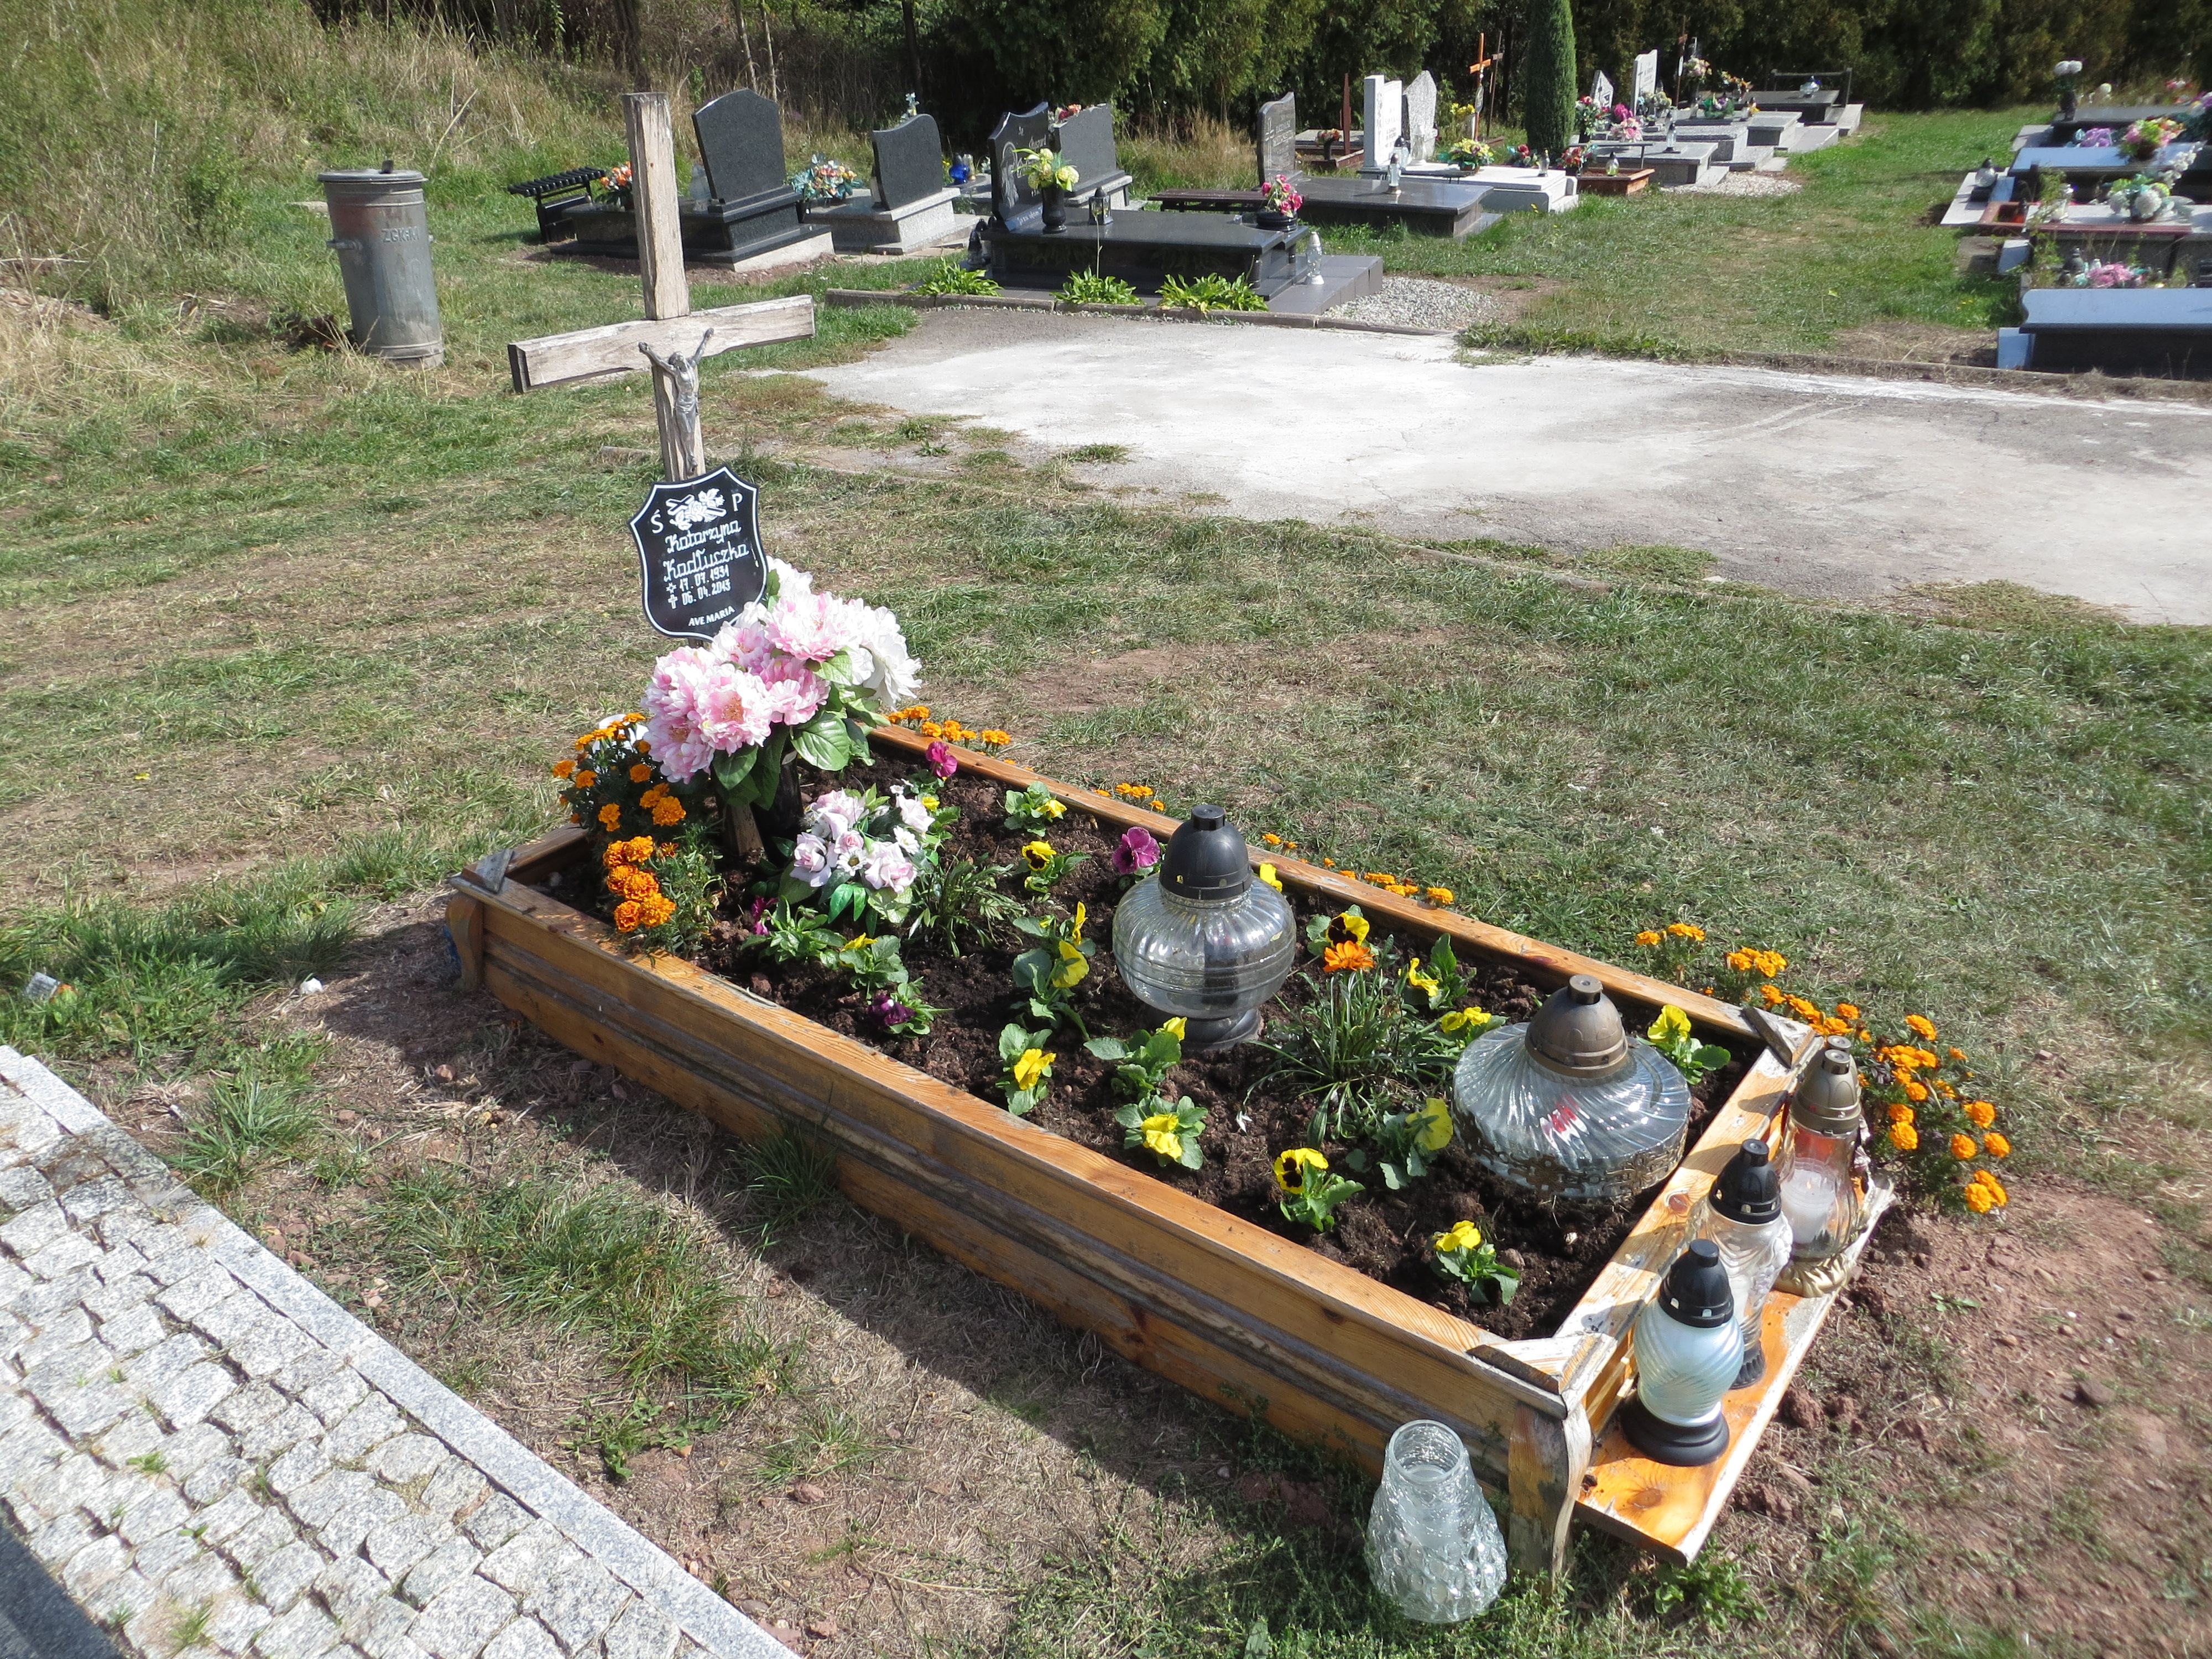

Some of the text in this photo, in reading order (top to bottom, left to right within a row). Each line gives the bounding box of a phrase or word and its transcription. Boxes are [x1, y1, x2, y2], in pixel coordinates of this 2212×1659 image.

[650, 493, 743, 534] Ś P
[665, 520, 742, 554] Katarzyna
[688, 606, 735, 626] AVE MARIA
